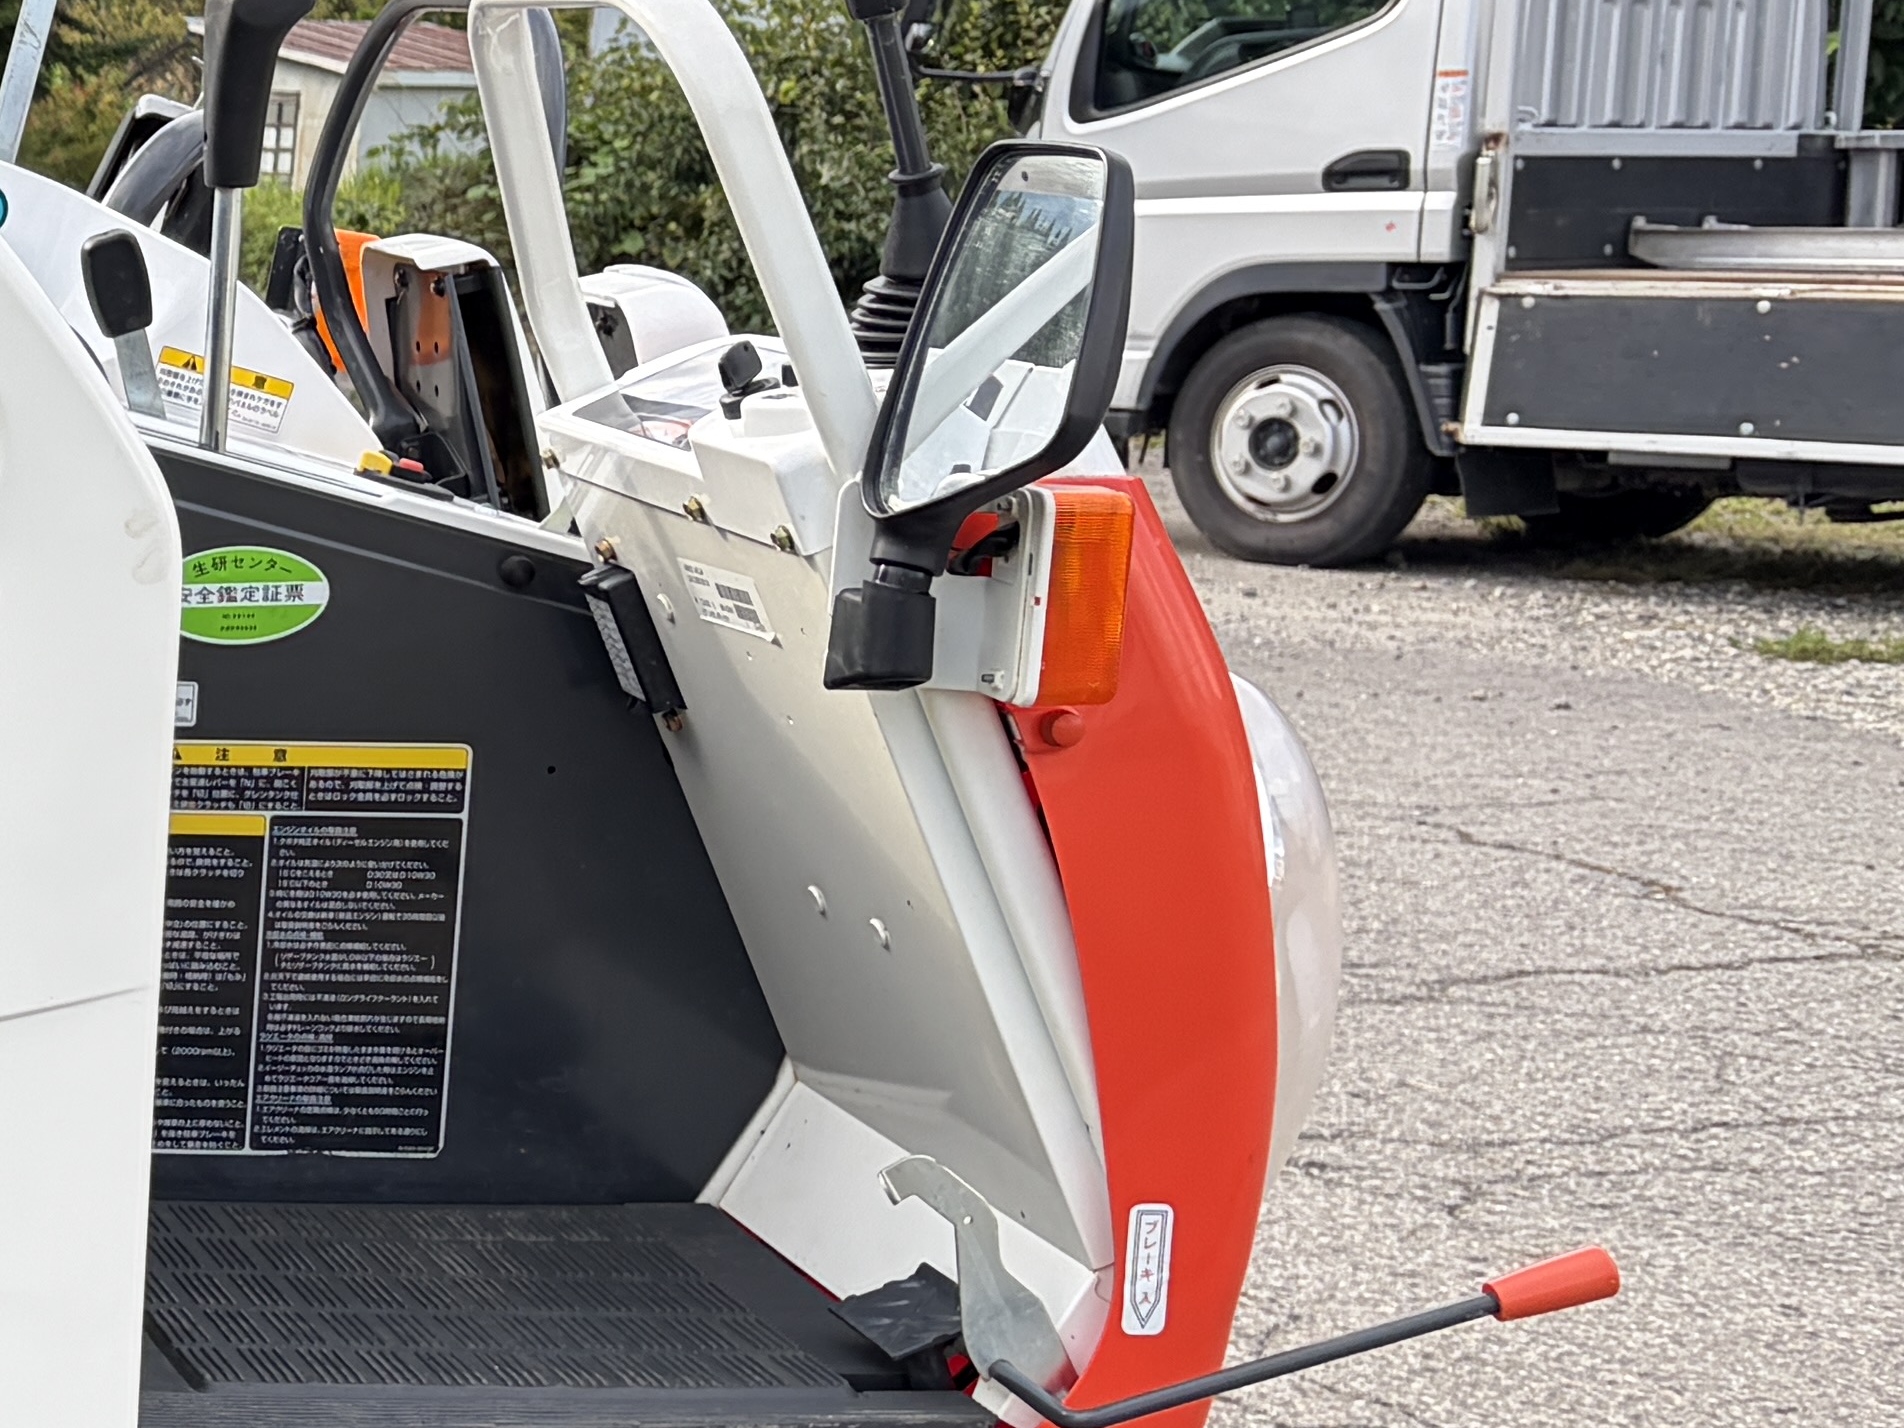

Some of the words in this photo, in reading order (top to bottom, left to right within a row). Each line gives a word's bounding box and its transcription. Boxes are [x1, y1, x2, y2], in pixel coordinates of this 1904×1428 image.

[192, 555, 293, 578] 生研センター
[181, 583, 305, 605] 安全鑑定証票
